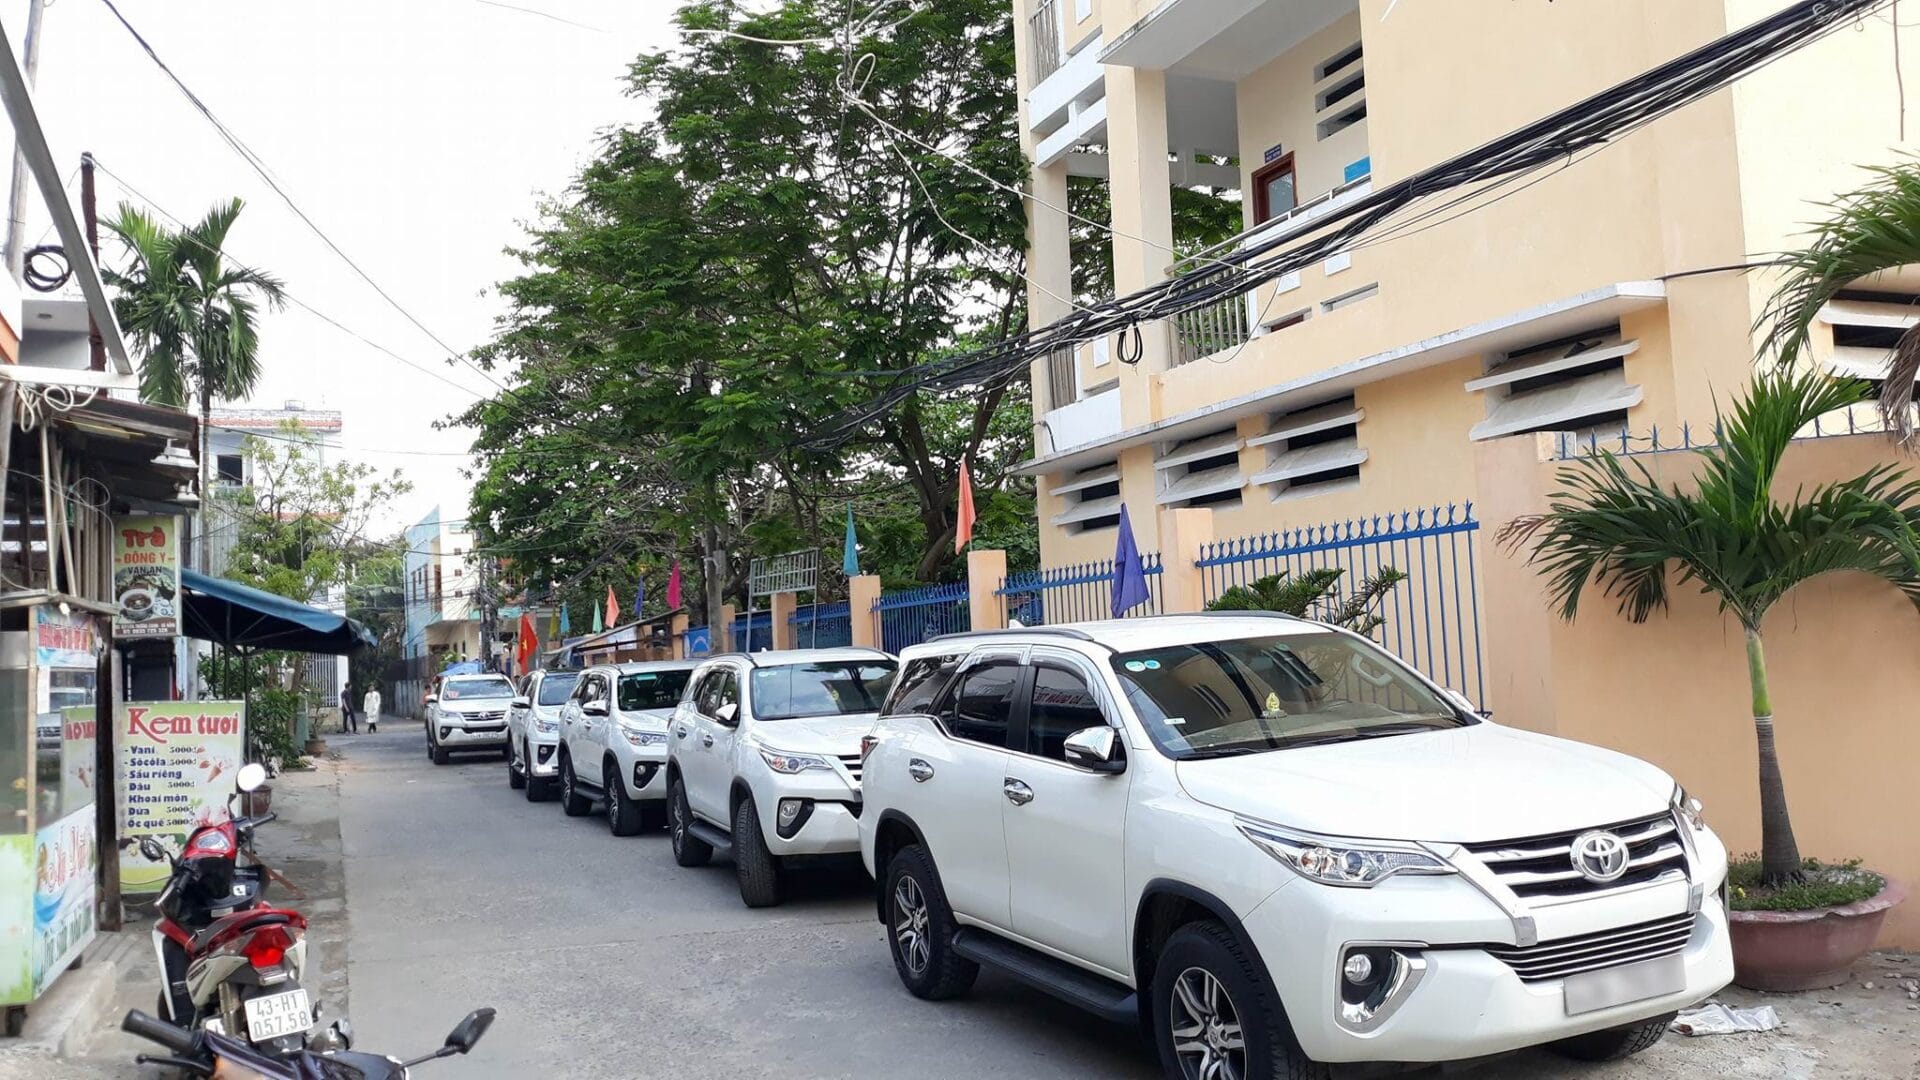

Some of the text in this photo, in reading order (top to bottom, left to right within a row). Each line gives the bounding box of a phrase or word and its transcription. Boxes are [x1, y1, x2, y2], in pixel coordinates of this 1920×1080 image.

[122, 526, 166, 548] Trà
[127, 708, 193, 744] Kem
[128, 794, 161, 803] Khoai
[256, 993, 298, 1017] 43-H1
[253, 1011, 308, 1036] 057.58
